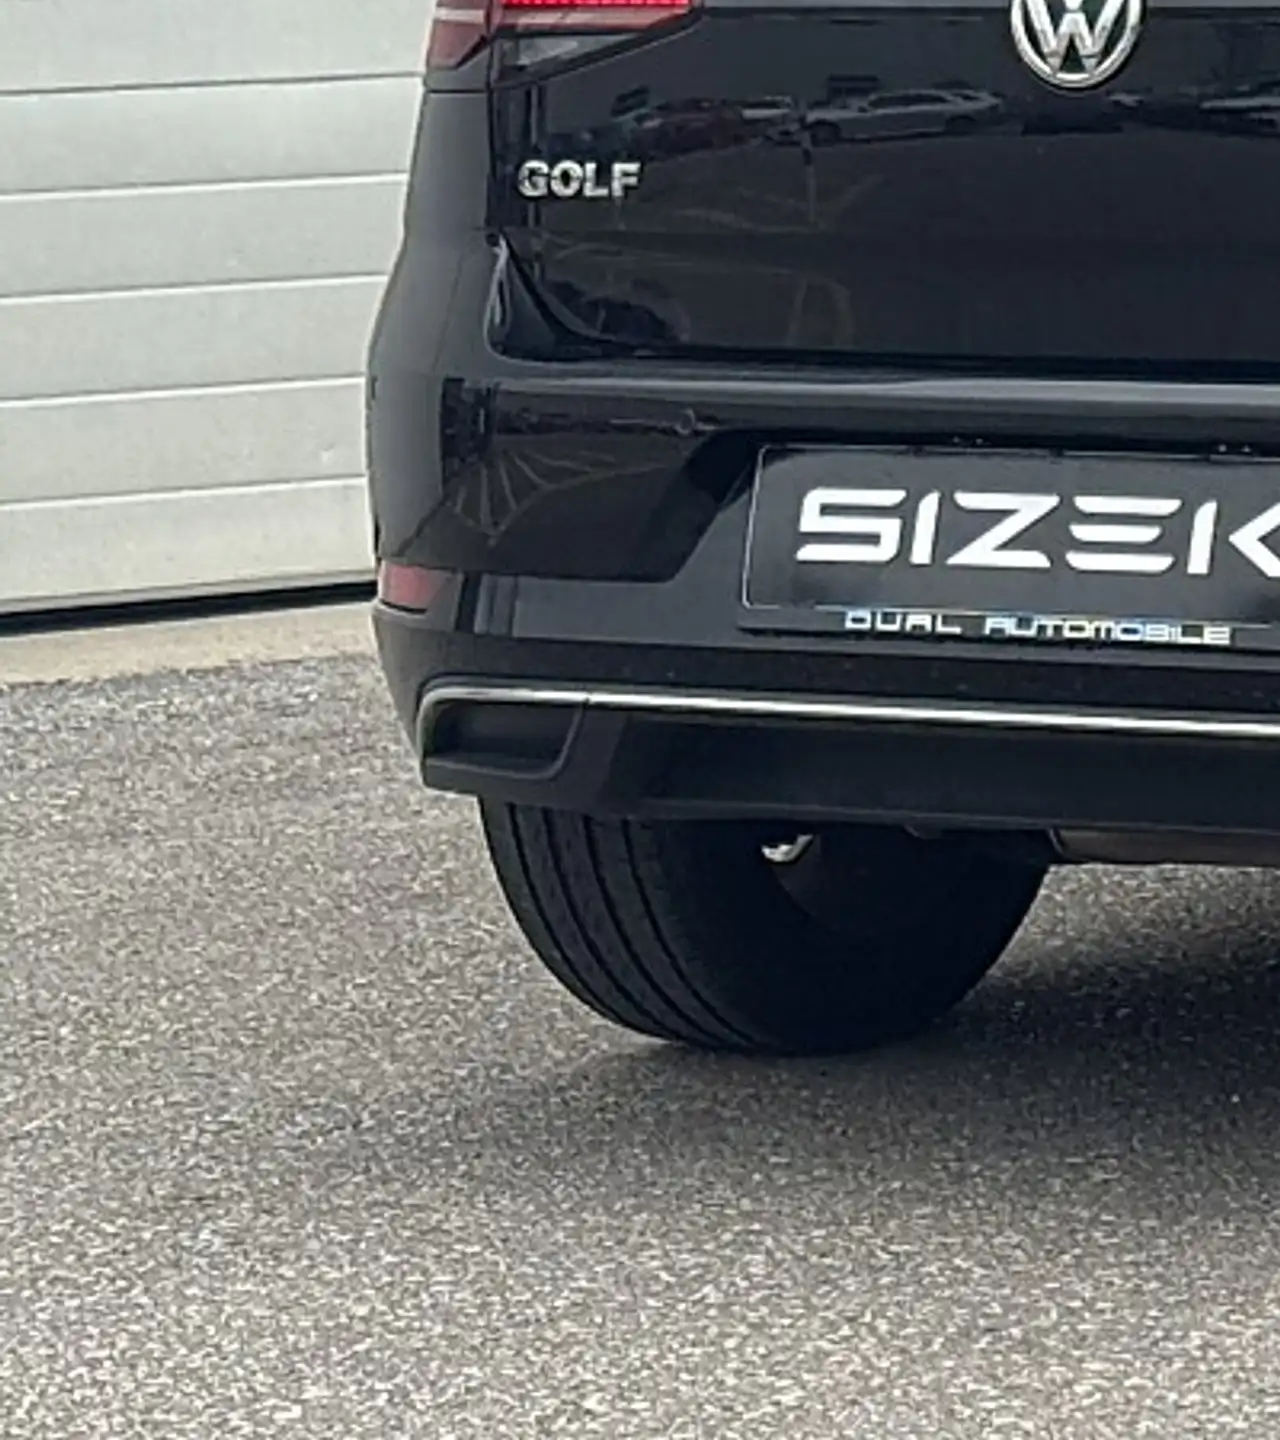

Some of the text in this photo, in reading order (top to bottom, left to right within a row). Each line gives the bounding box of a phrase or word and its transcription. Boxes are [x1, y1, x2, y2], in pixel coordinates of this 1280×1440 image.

[518, 160, 641, 197] GOLF
[845, 609, 1231, 645] DUAL AUTOMOBILE
